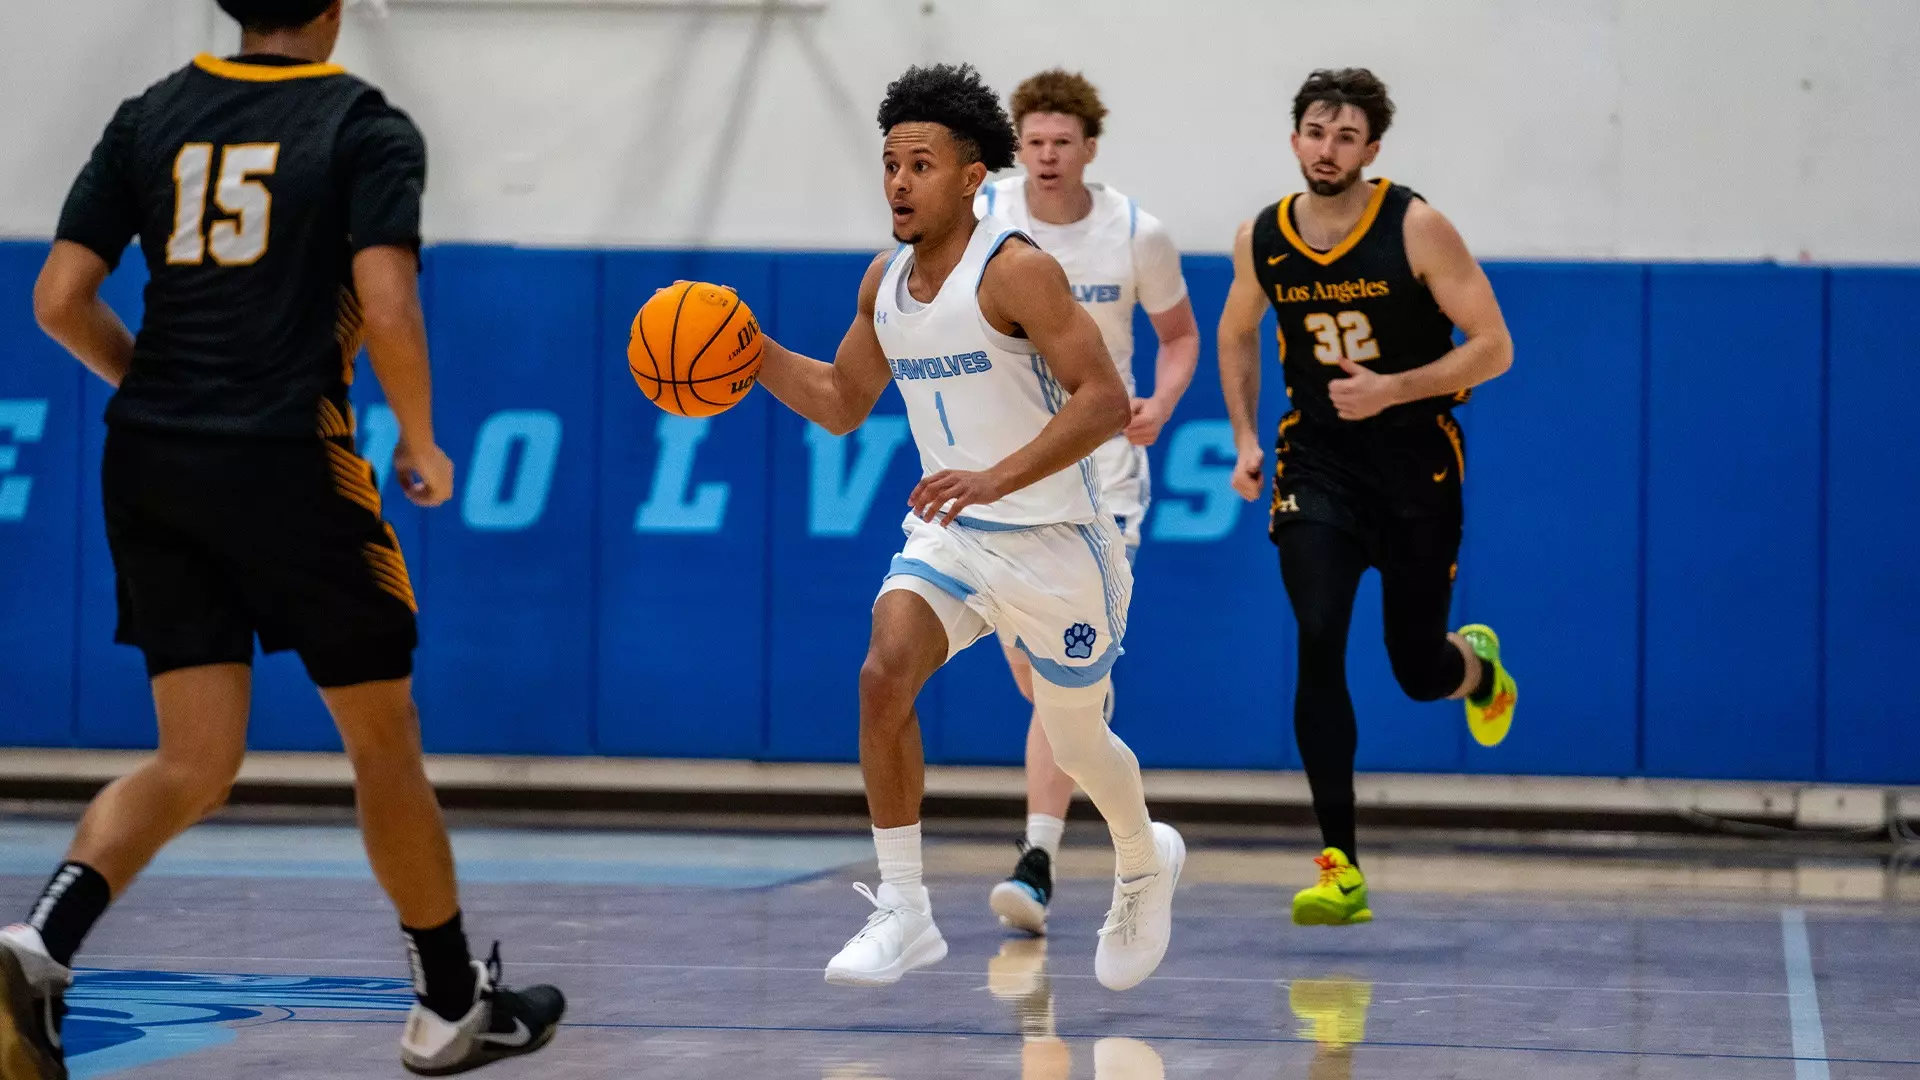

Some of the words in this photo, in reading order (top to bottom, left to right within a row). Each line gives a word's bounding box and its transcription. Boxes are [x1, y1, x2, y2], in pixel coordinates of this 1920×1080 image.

[165, 141, 280, 266] 15
[1274, 283, 1310, 302] Los
[1312, 277, 1390, 303] Angeles
[1304, 310, 1380, 365] 32
[934, 391, 955, 446] 1
